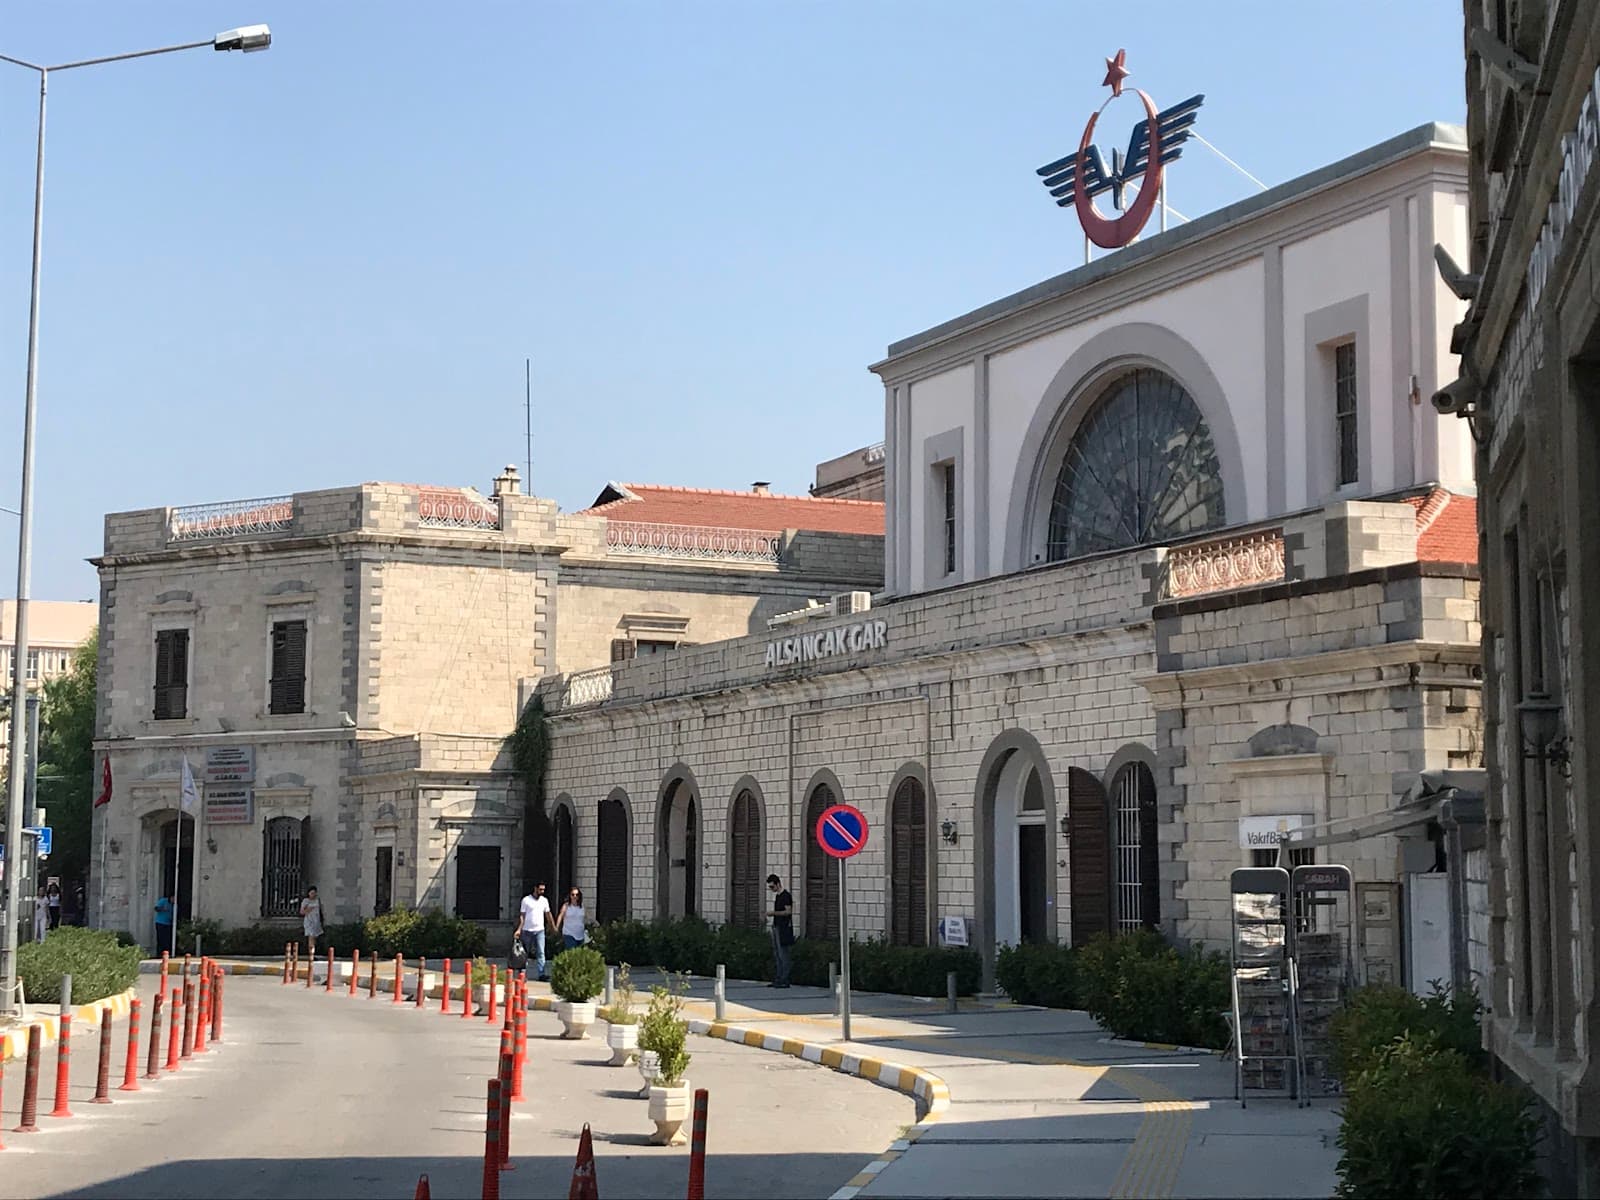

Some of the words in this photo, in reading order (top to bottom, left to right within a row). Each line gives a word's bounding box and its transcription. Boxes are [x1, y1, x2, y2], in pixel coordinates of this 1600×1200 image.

[765, 628, 848, 668] ALSANCAK
[851, 621, 888, 651] GAR
[1247, 831, 1281, 845] VakıfBa
